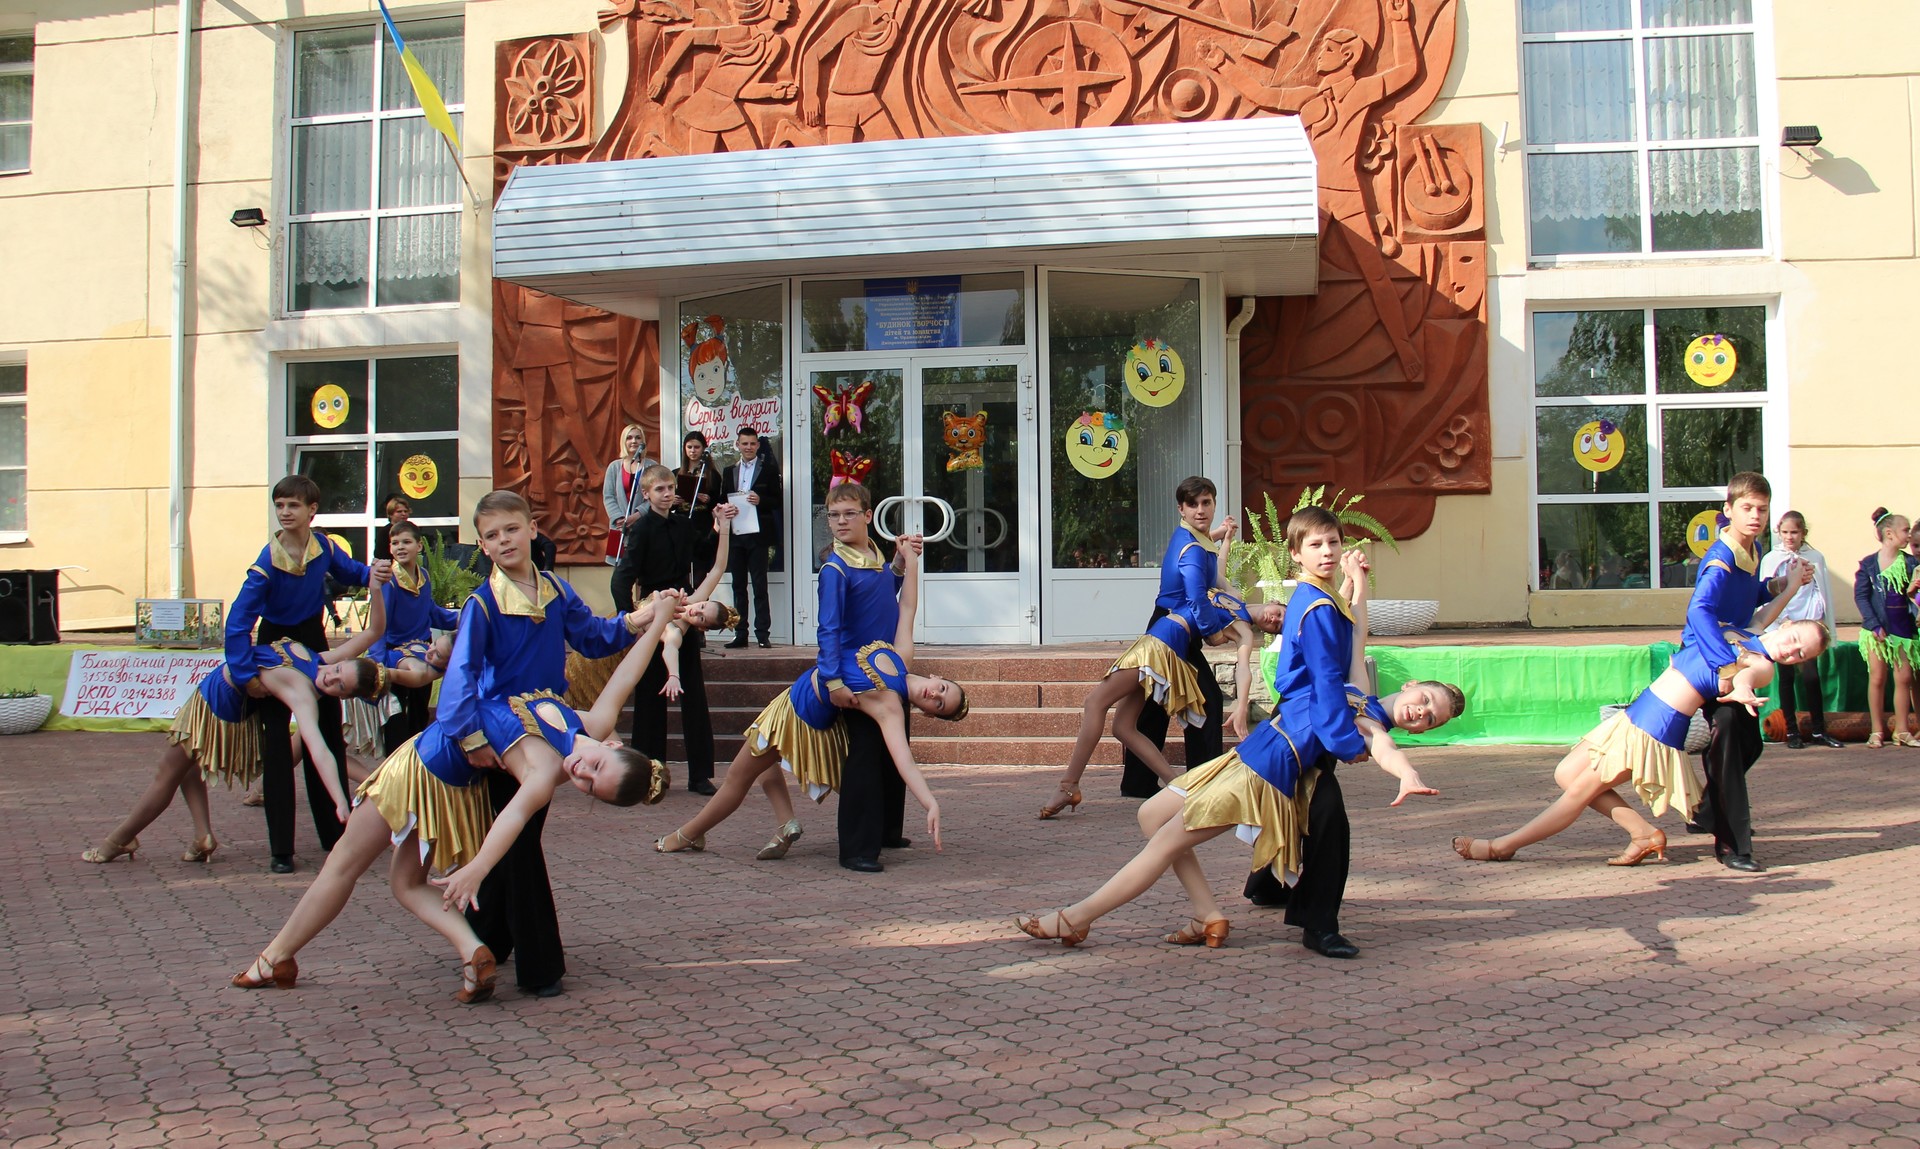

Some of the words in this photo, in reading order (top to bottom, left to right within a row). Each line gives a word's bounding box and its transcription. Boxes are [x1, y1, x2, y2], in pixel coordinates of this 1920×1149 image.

[689, 401, 725, 431] Серця
[730, 396, 779, 422] відкриті
[80, 653, 166, 676] Благодійний
[168, 657, 222, 675] рахунок
[77, 684, 117, 700] ОКПО
[121, 688, 177, 701] 02142388
[73, 700, 149, 716] ГУДКСУ
